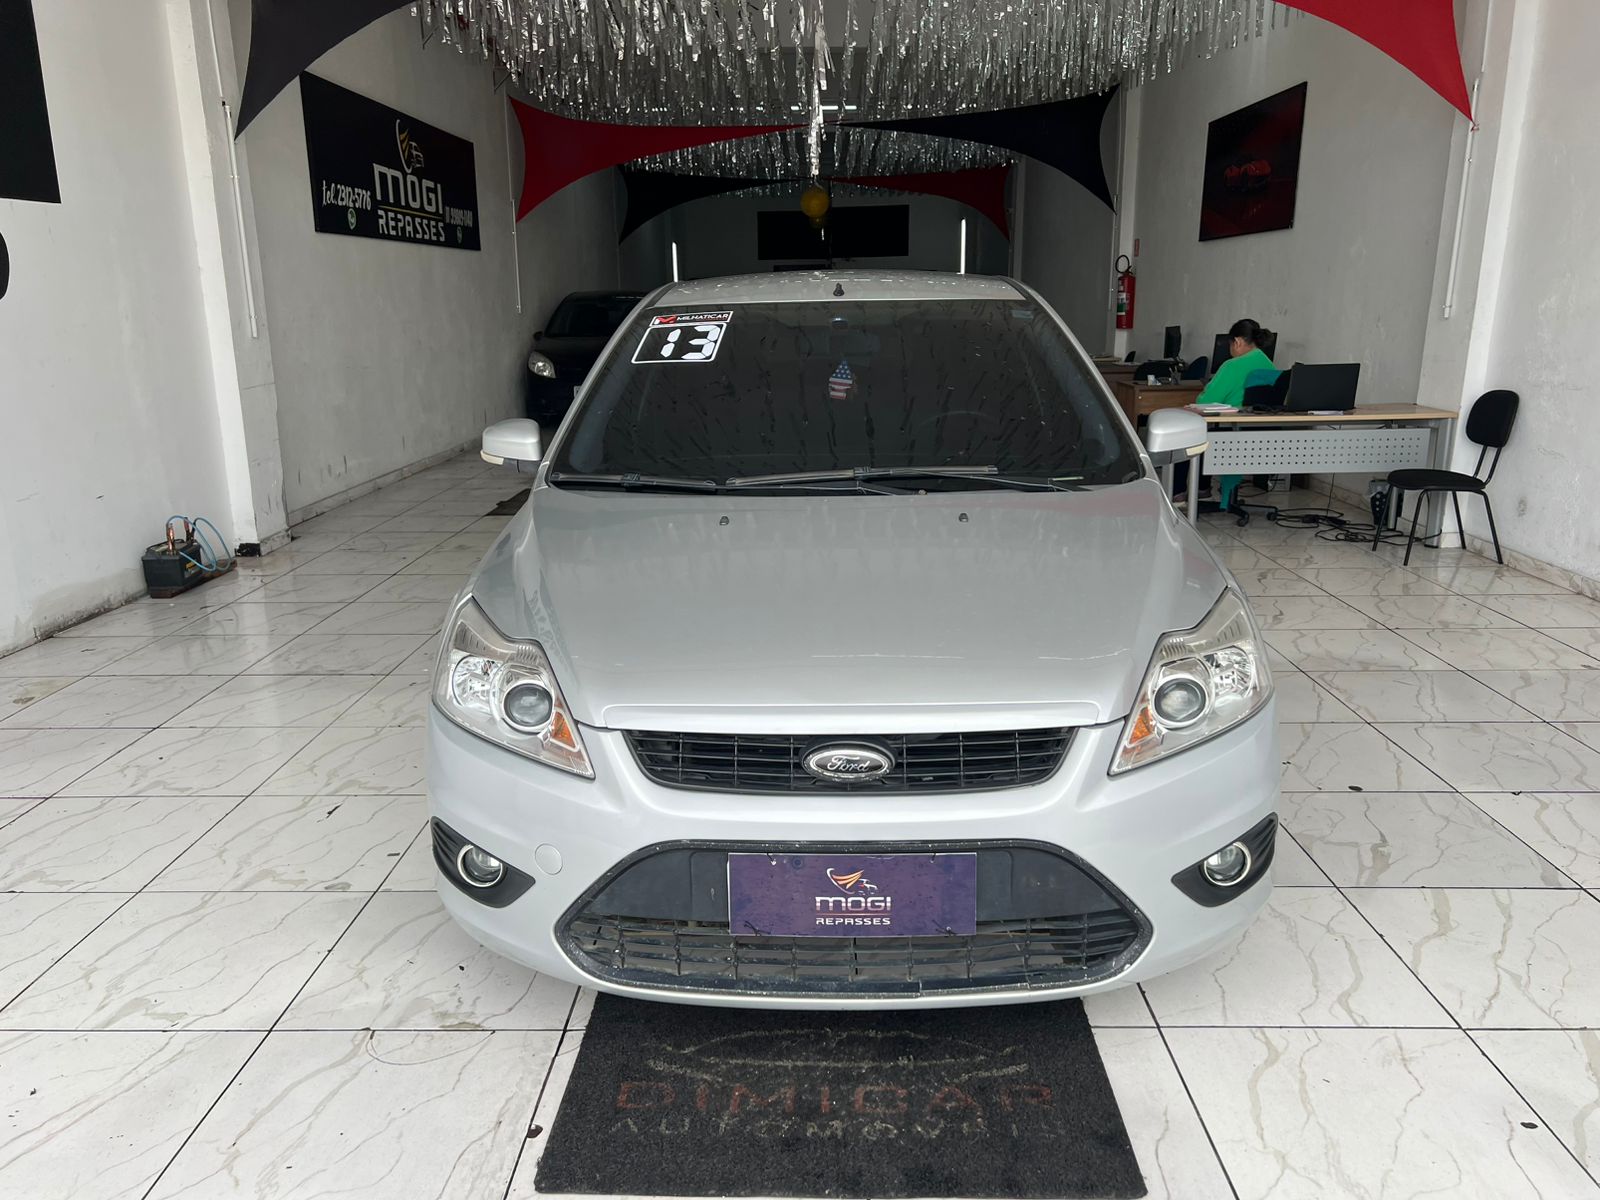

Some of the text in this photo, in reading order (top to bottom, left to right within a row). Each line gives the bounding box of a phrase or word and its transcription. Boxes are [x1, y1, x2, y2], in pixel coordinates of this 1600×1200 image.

[372, 162, 444, 214] MOGI
[377, 208, 446, 242] REPASSES
[660, 324, 721, 360] 13
[827, 754, 871, 772] Ford
[815, 896, 892, 911] MOGI
[815, 917, 891, 926] REPASSES
[616, 1081, 1054, 1113] DIMICAR
